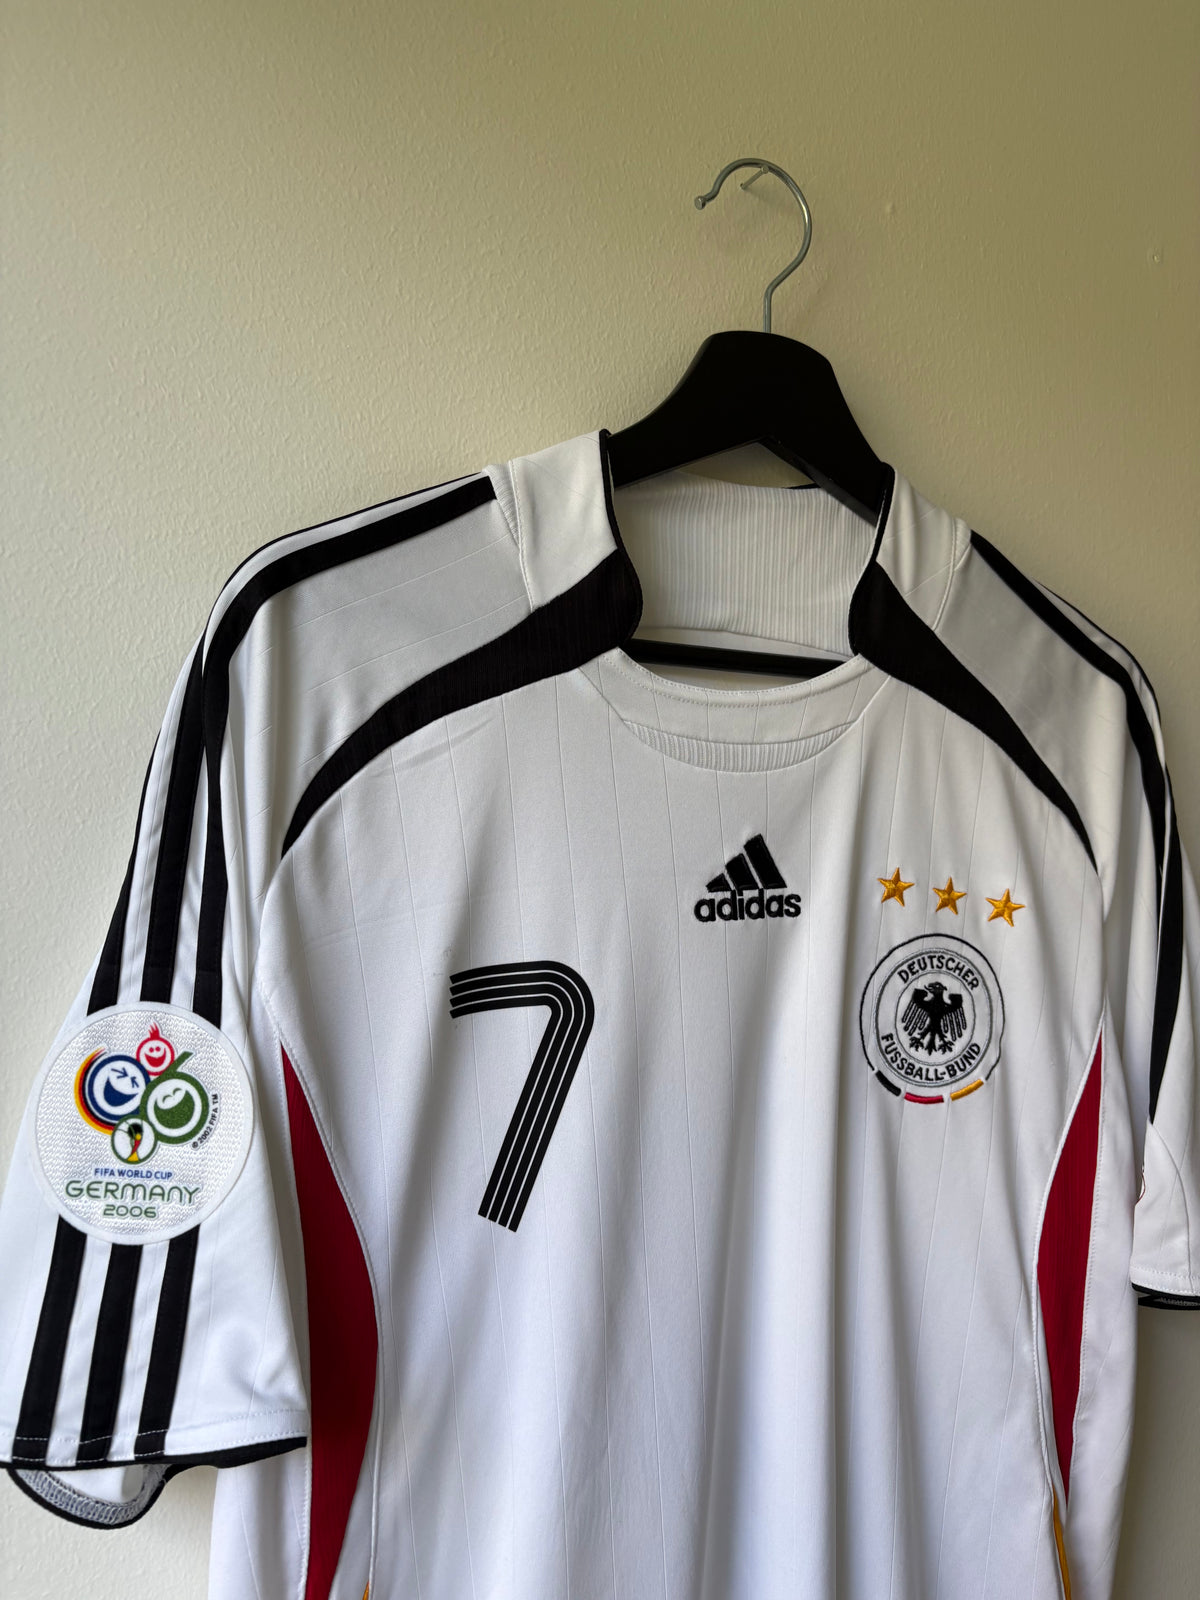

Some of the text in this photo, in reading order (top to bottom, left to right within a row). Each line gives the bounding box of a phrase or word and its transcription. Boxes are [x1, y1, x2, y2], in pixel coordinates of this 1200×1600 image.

[694, 888, 801, 922] adidas
[897, 955, 979, 990] DEUTSCHER
[881, 1032, 981, 1081] FUSSBALL-BUND
[449, 960, 595, 1233] 7
[197, 1126, 213, 1144] 2002
[209, 1107, 218, 1126] FIFA
[94, 1168, 173, 1180] FIFA WORLD CUP
[65, 1180, 200, 1204] GERMANY
[103, 1204, 157, 1218] 2006
